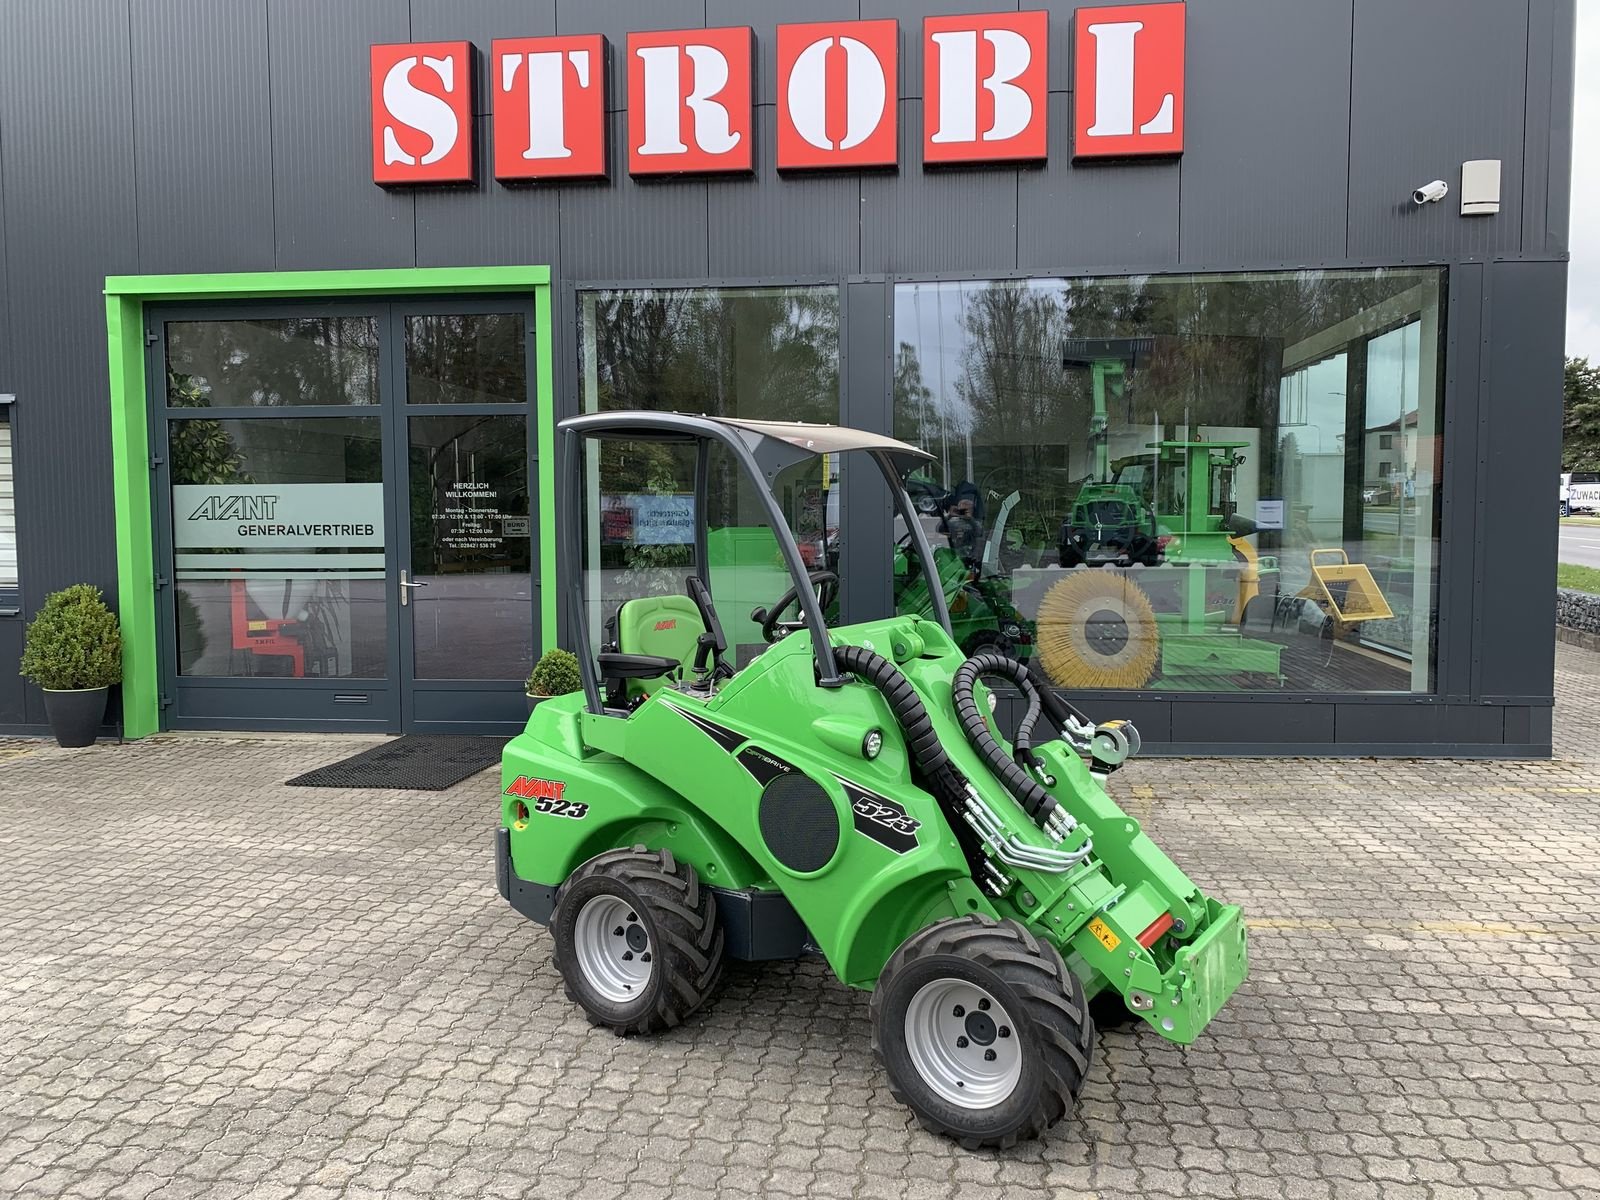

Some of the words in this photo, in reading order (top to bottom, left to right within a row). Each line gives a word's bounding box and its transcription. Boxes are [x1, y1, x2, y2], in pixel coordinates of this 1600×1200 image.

[382, 21, 1175, 166] STROBL
[453, 482, 489, 490] HERZLICH
[187, 495, 277, 521] AVANT
[237, 524, 374, 536] GENERALVERTRIEB
[504, 775, 566, 800] AVANT
[535, 796, 590, 819] 523
[853, 797, 923, 835] 523
